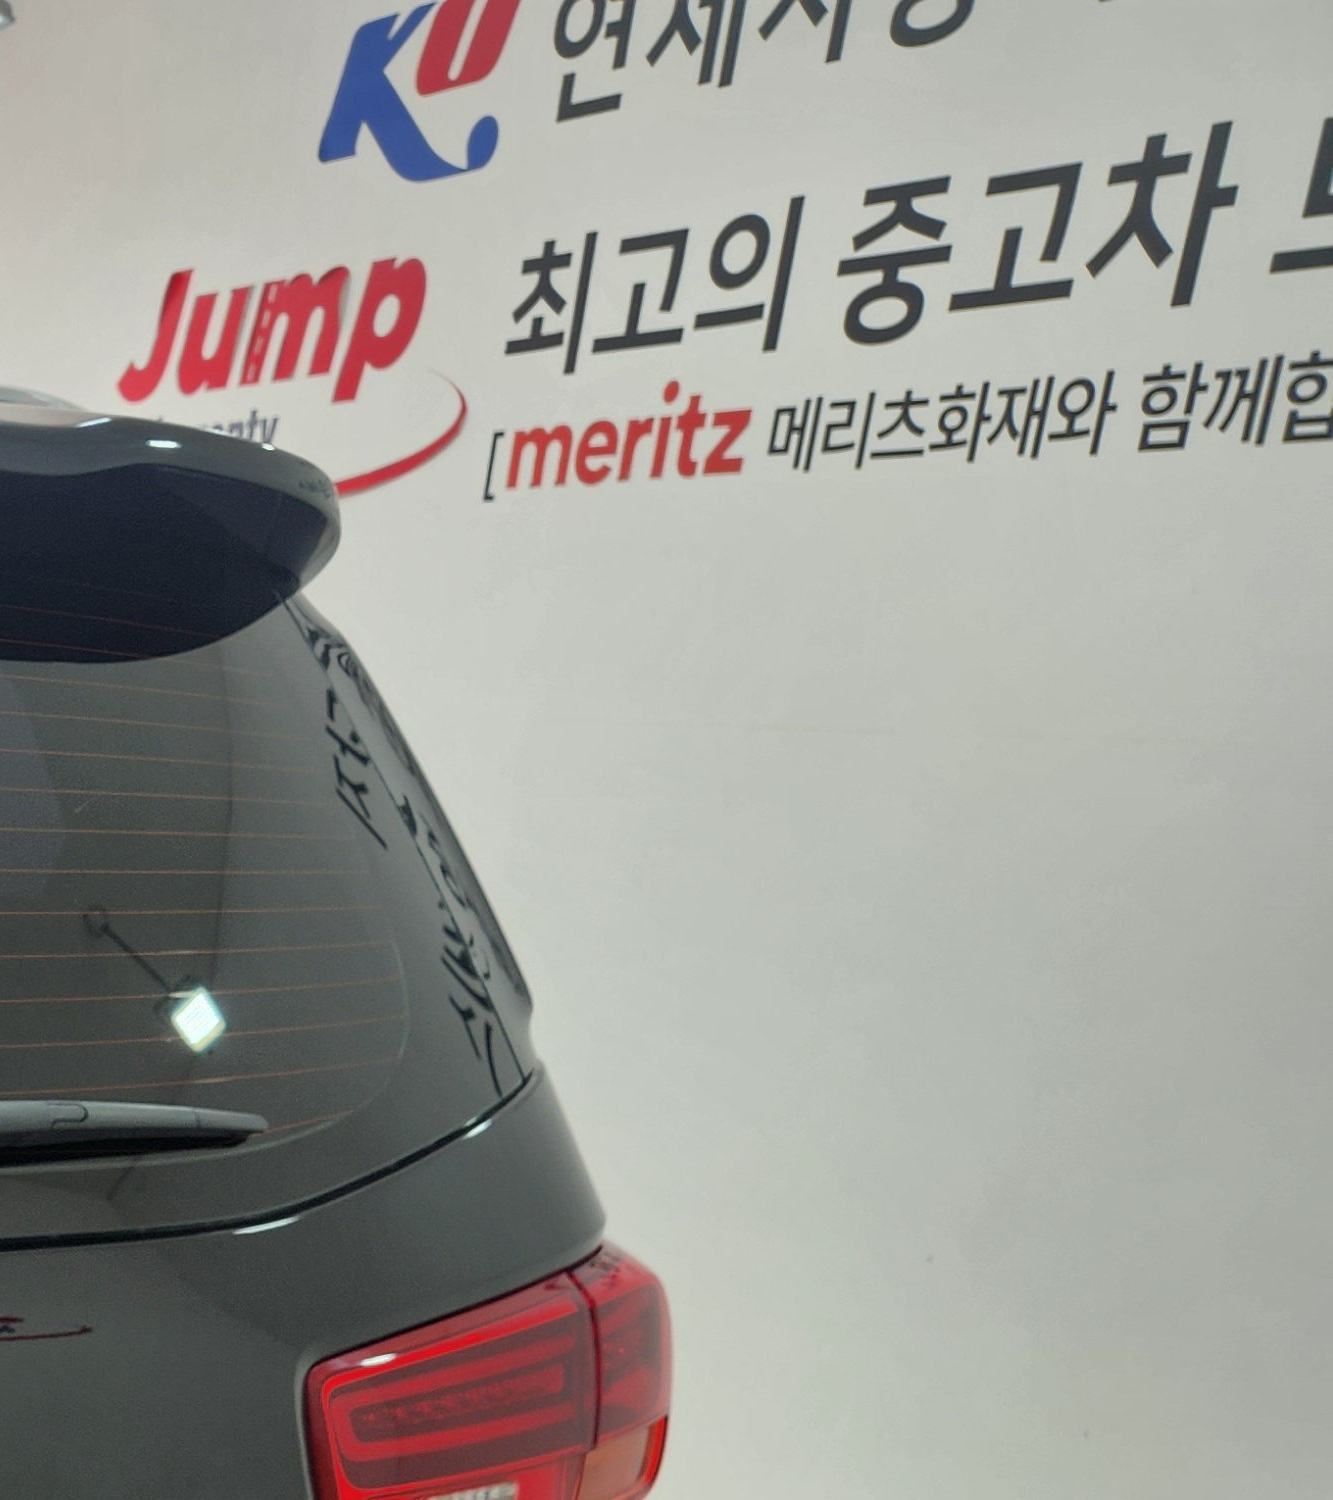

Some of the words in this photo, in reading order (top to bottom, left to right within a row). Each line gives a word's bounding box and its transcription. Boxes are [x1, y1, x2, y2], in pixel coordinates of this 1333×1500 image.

[505, 196, 806, 375] 최고의
[835, 120, 1239, 347] 중고차
[116, 256, 427, 405] Jump
[767, 370, 1116, 473] 메리츠화재와
